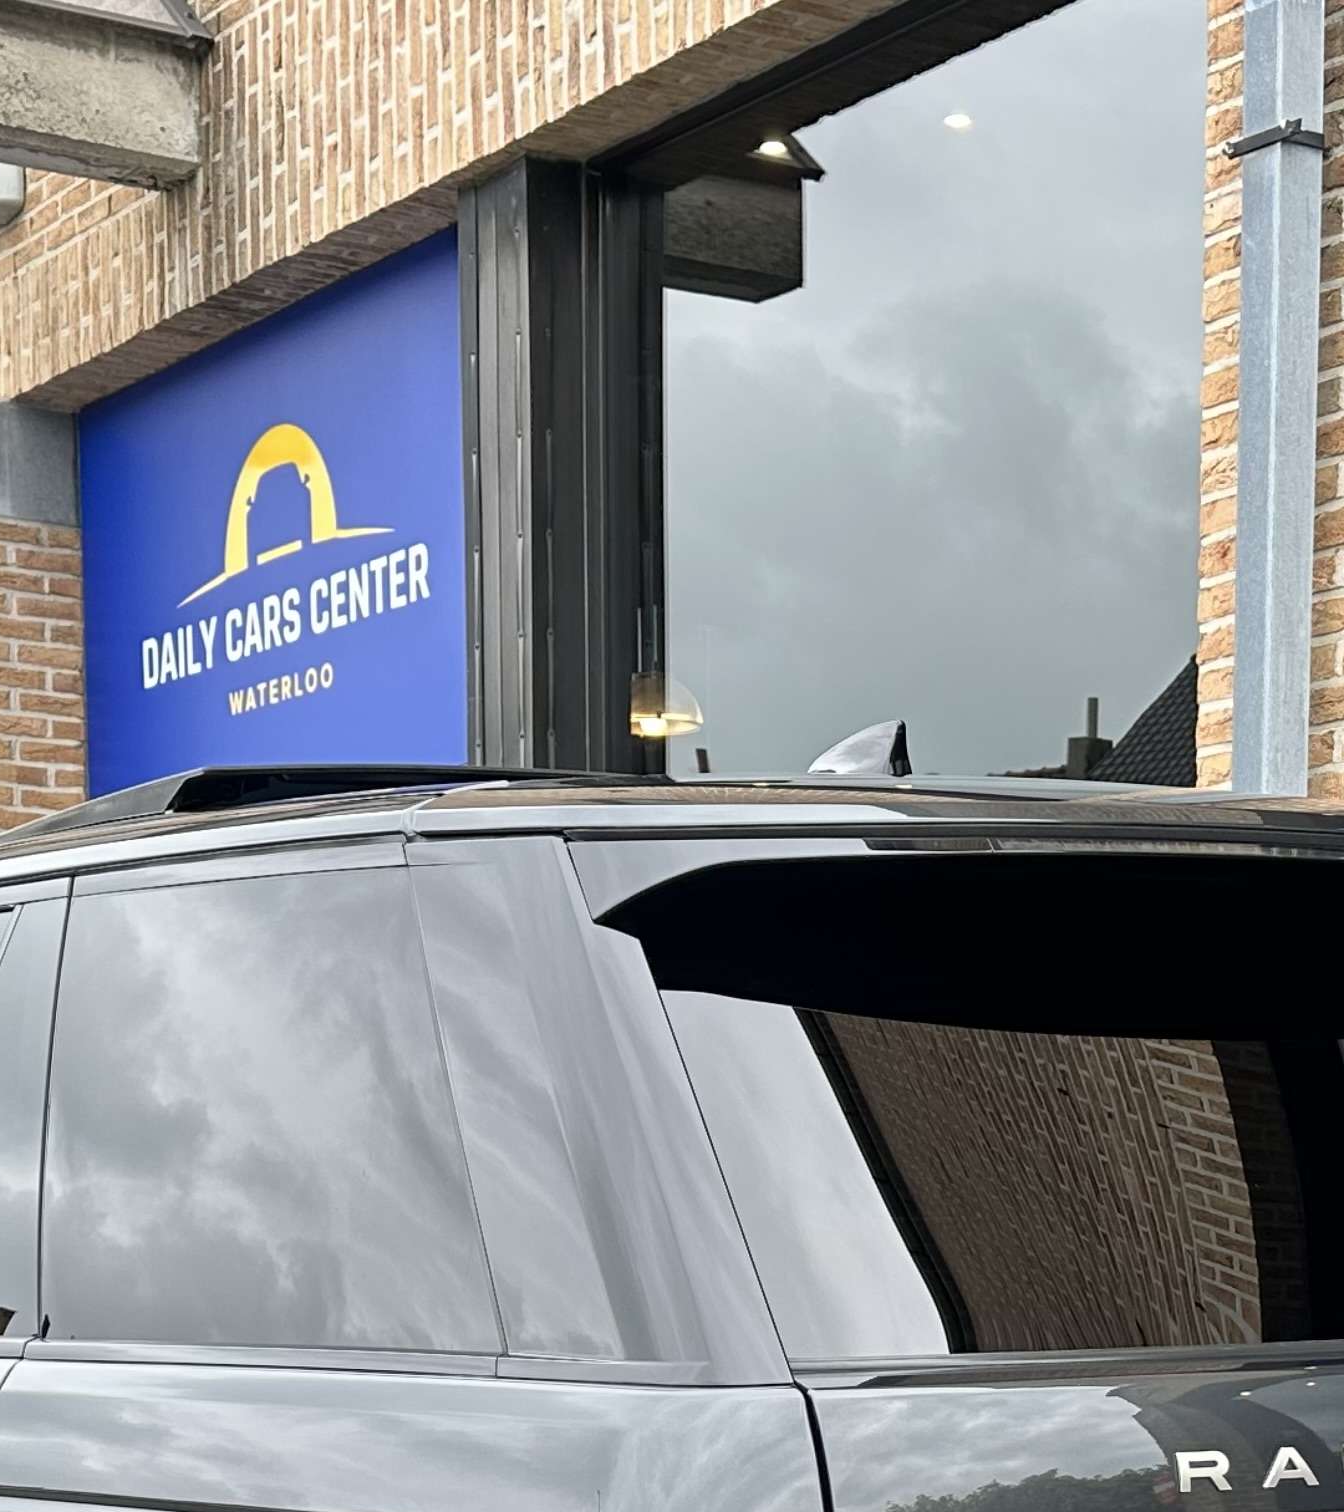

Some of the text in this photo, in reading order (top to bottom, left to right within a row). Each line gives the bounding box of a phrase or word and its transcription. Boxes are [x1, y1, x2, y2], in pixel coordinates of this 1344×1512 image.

[142, 542, 431, 690] DAILY CARS CENTER
[228, 661, 334, 717] WATERLOO
